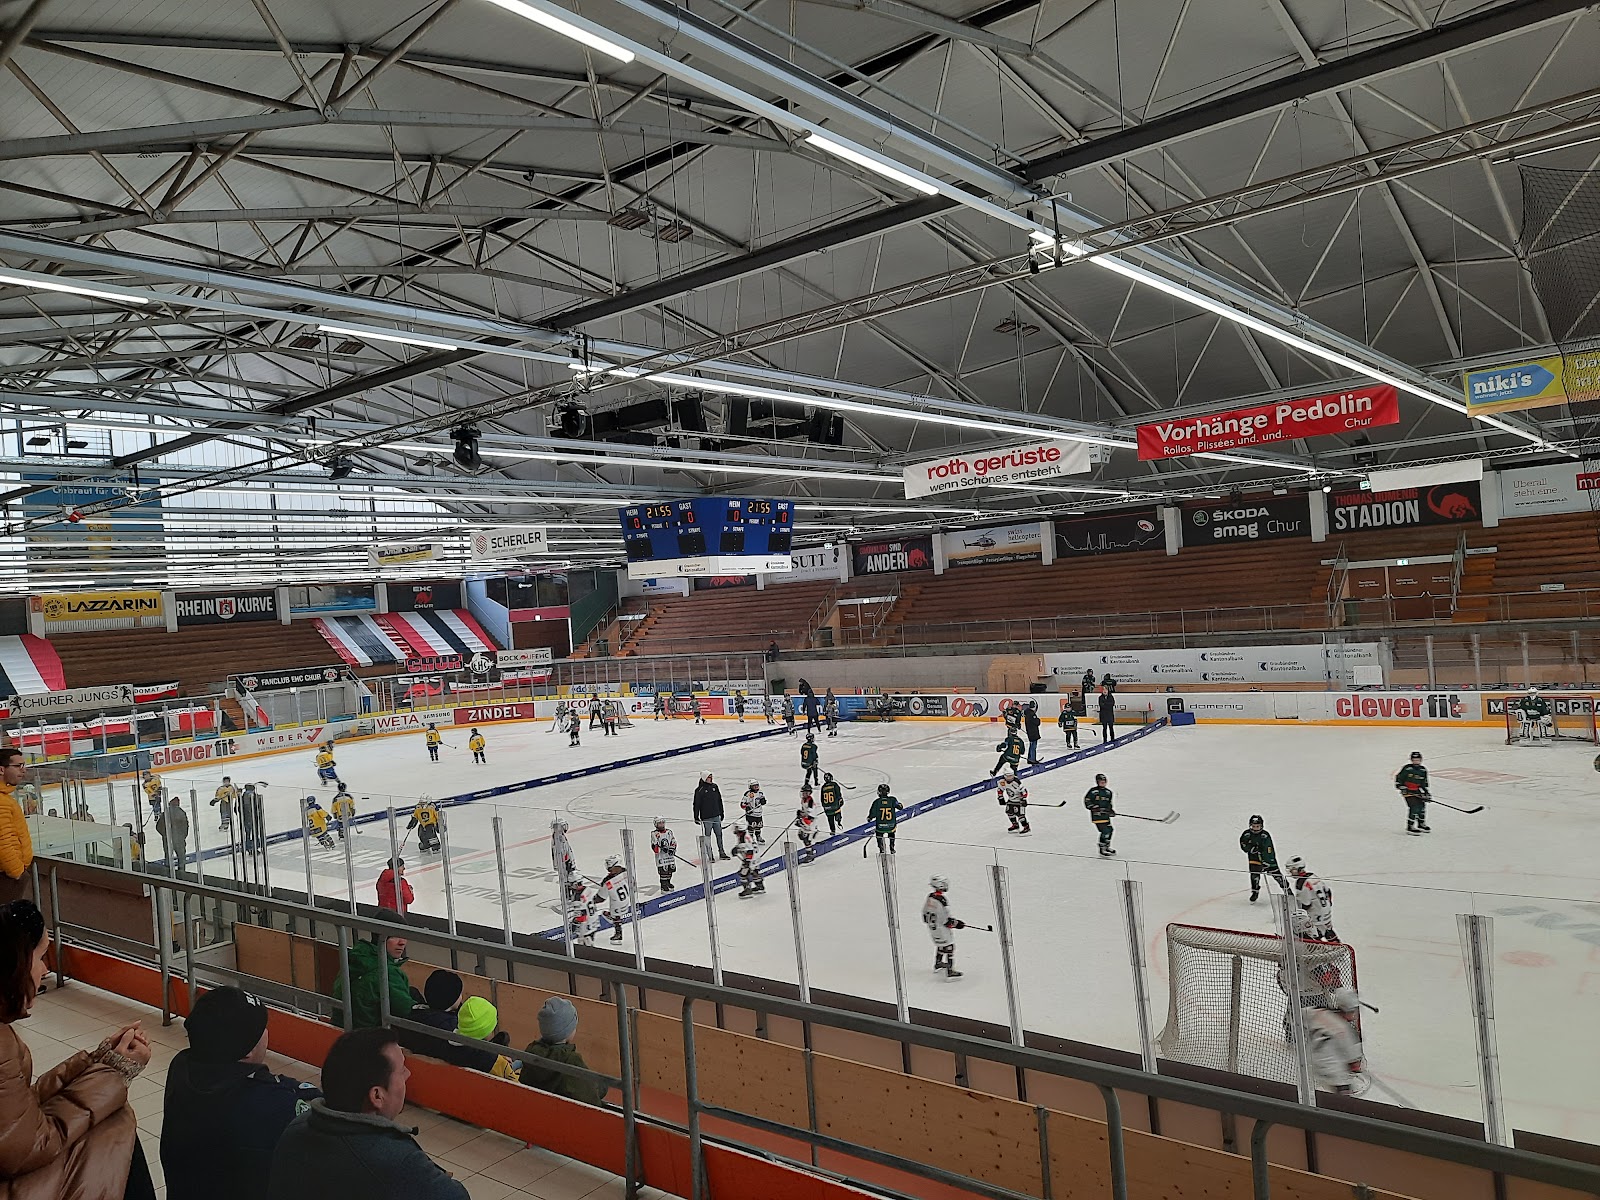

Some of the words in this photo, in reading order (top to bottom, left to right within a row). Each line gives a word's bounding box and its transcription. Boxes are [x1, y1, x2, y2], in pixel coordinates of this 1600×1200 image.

[1474, 371, 1532, 394] niki's
[1155, 413, 1268, 442] Vorhänge
[1275, 394, 1372, 425] Pedolin
[1344, 416, 1373, 428] Chur
[1197, 438, 1235, 451] Plissées
[927, 459, 969, 479] roth
[973, 446, 1061, 476] gerüste
[929, 480, 959, 492] wenn
[960, 473, 1009, 487] Schönes
[1011, 464, 1061, 481] entsteht
[1334, 491, 1373, 507] THOMAS
[1212, 506, 1270, 522] ŠKODA
[1334, 499, 1420, 530] STADION
[1213, 521, 1259, 539] amag
[1266, 520, 1302, 533] Chur
[491, 531, 542, 549] SCHERLER
[866, 551, 909, 573] ANDERI
[67, 597, 157, 613] LAZZARINI
[176, 599, 215, 617] RHEIN
[237, 596, 274, 613] KURVE
[406, 654, 461, 673] CHUR
[261, 676, 290, 686] FANCLUB
[291, 675, 304, 683] EHC
[304, 673, 321, 682] CHUR
[23, 694, 74, 709] CHURER
[77, 690, 119, 703] JUNGS
[1336, 694, 1423, 718] clever
[1426, 694, 1462, 719] fit
[376, 714, 420, 728] WETA
[468, 706, 522, 722] ZINDEL
[257, 732, 303, 746] WEBER
[152, 744, 213, 766] clever
[214, 739, 236, 757] fit
[803, 749, 809, 760] 9
[1012, 744, 1020, 755] 16
[823, 792, 835, 804] 96
[879, 808, 893, 821] 75
